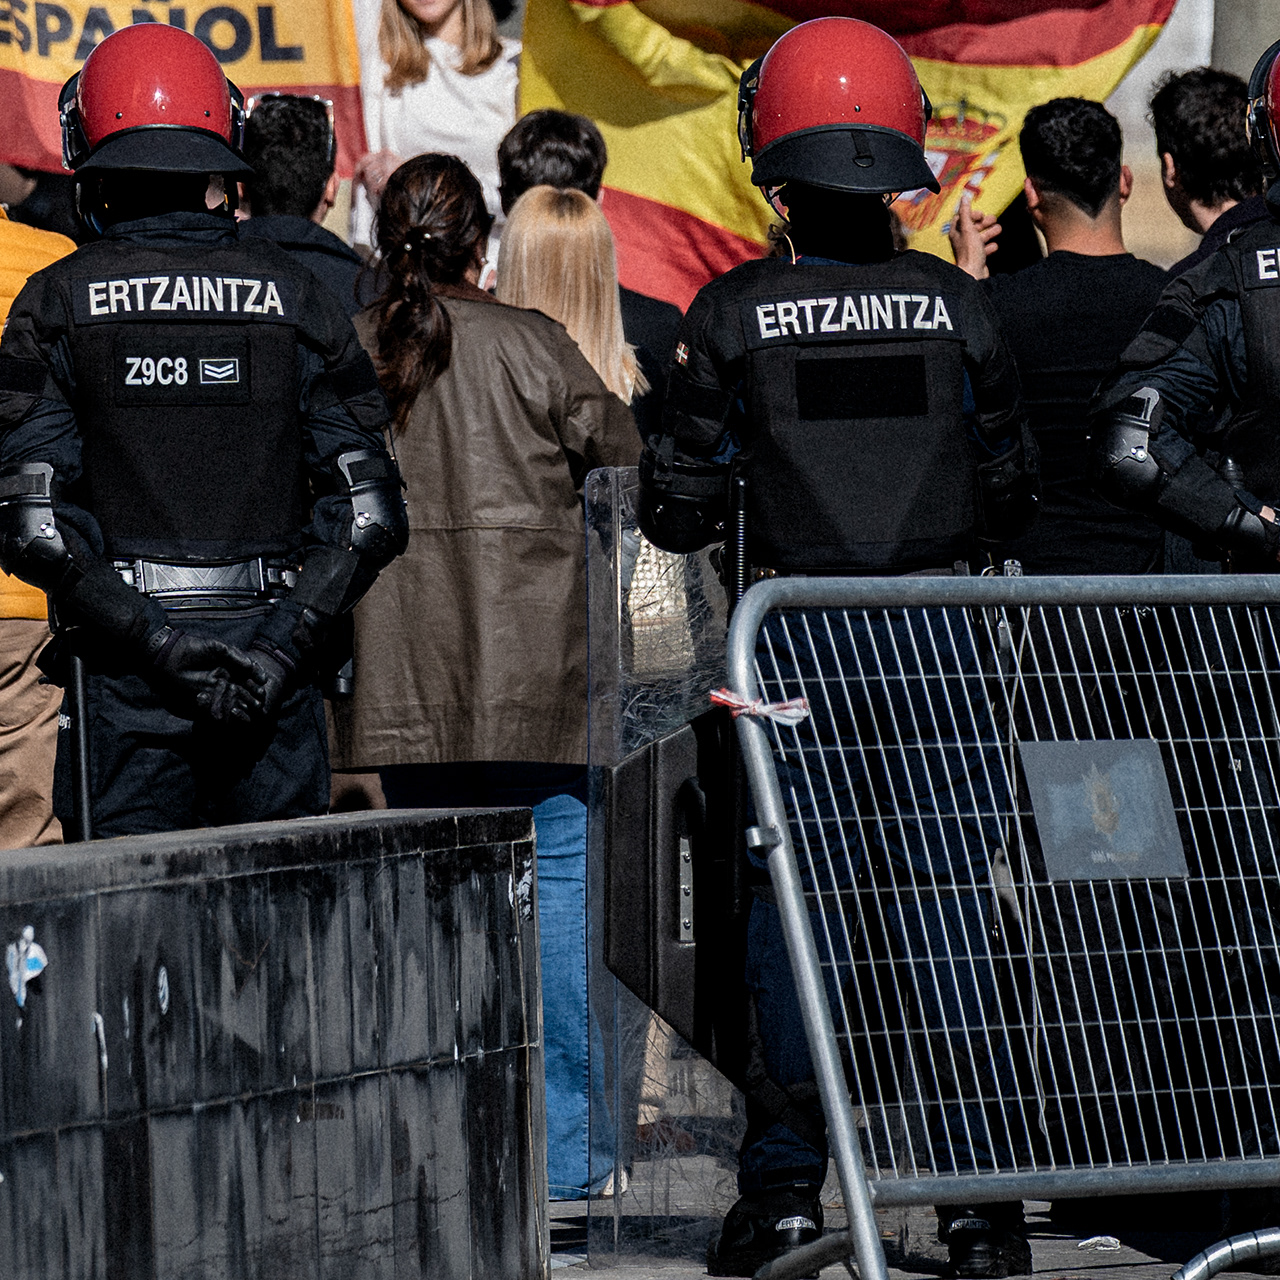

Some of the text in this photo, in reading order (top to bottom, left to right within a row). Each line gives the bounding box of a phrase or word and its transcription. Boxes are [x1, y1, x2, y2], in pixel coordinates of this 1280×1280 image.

[88, 276, 284, 316] ERTZAINTZA
[756, 294, 953, 339] ERTZAINTZA
[125, 357, 188, 385] Z9C8
